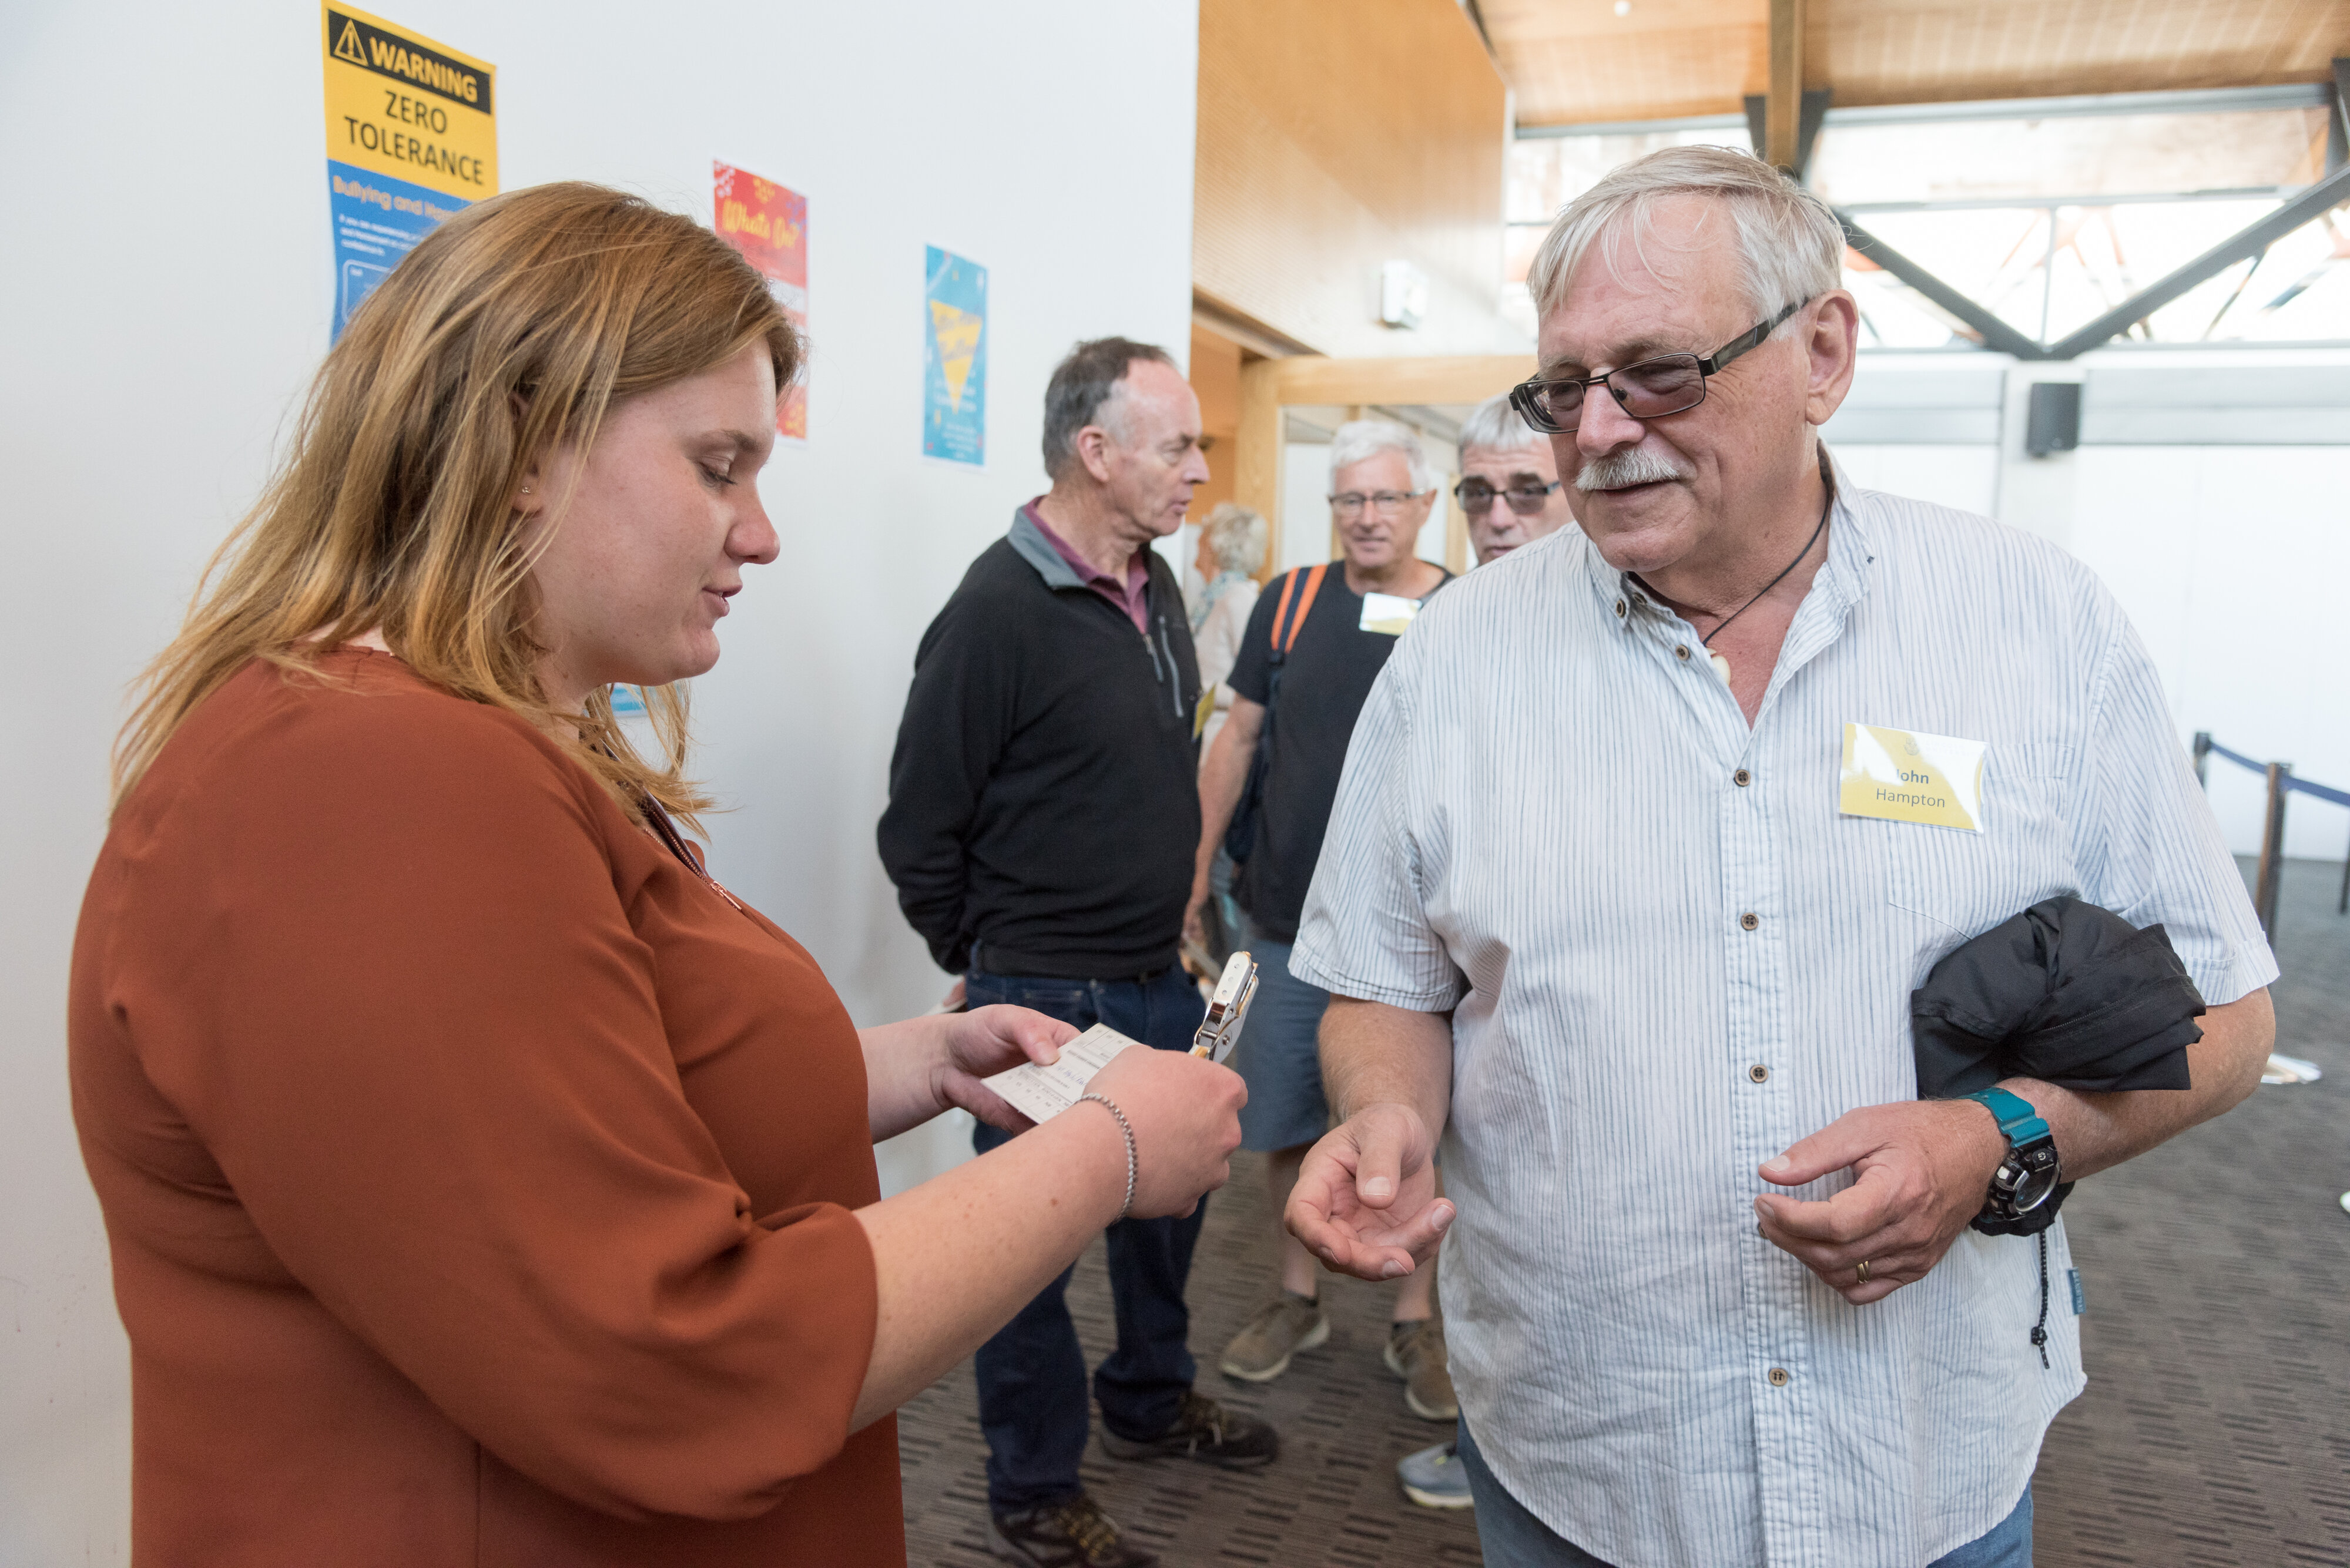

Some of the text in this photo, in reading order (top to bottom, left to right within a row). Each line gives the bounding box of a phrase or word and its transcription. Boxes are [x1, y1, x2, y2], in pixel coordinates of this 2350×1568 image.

[369, 36, 478, 103] WARNING
[385, 90, 447, 134] ZERO
[344, 116, 483, 185] TOLERANCE
[393, 196, 423, 216] and
[1876, 788, 1945, 808] Hampton
